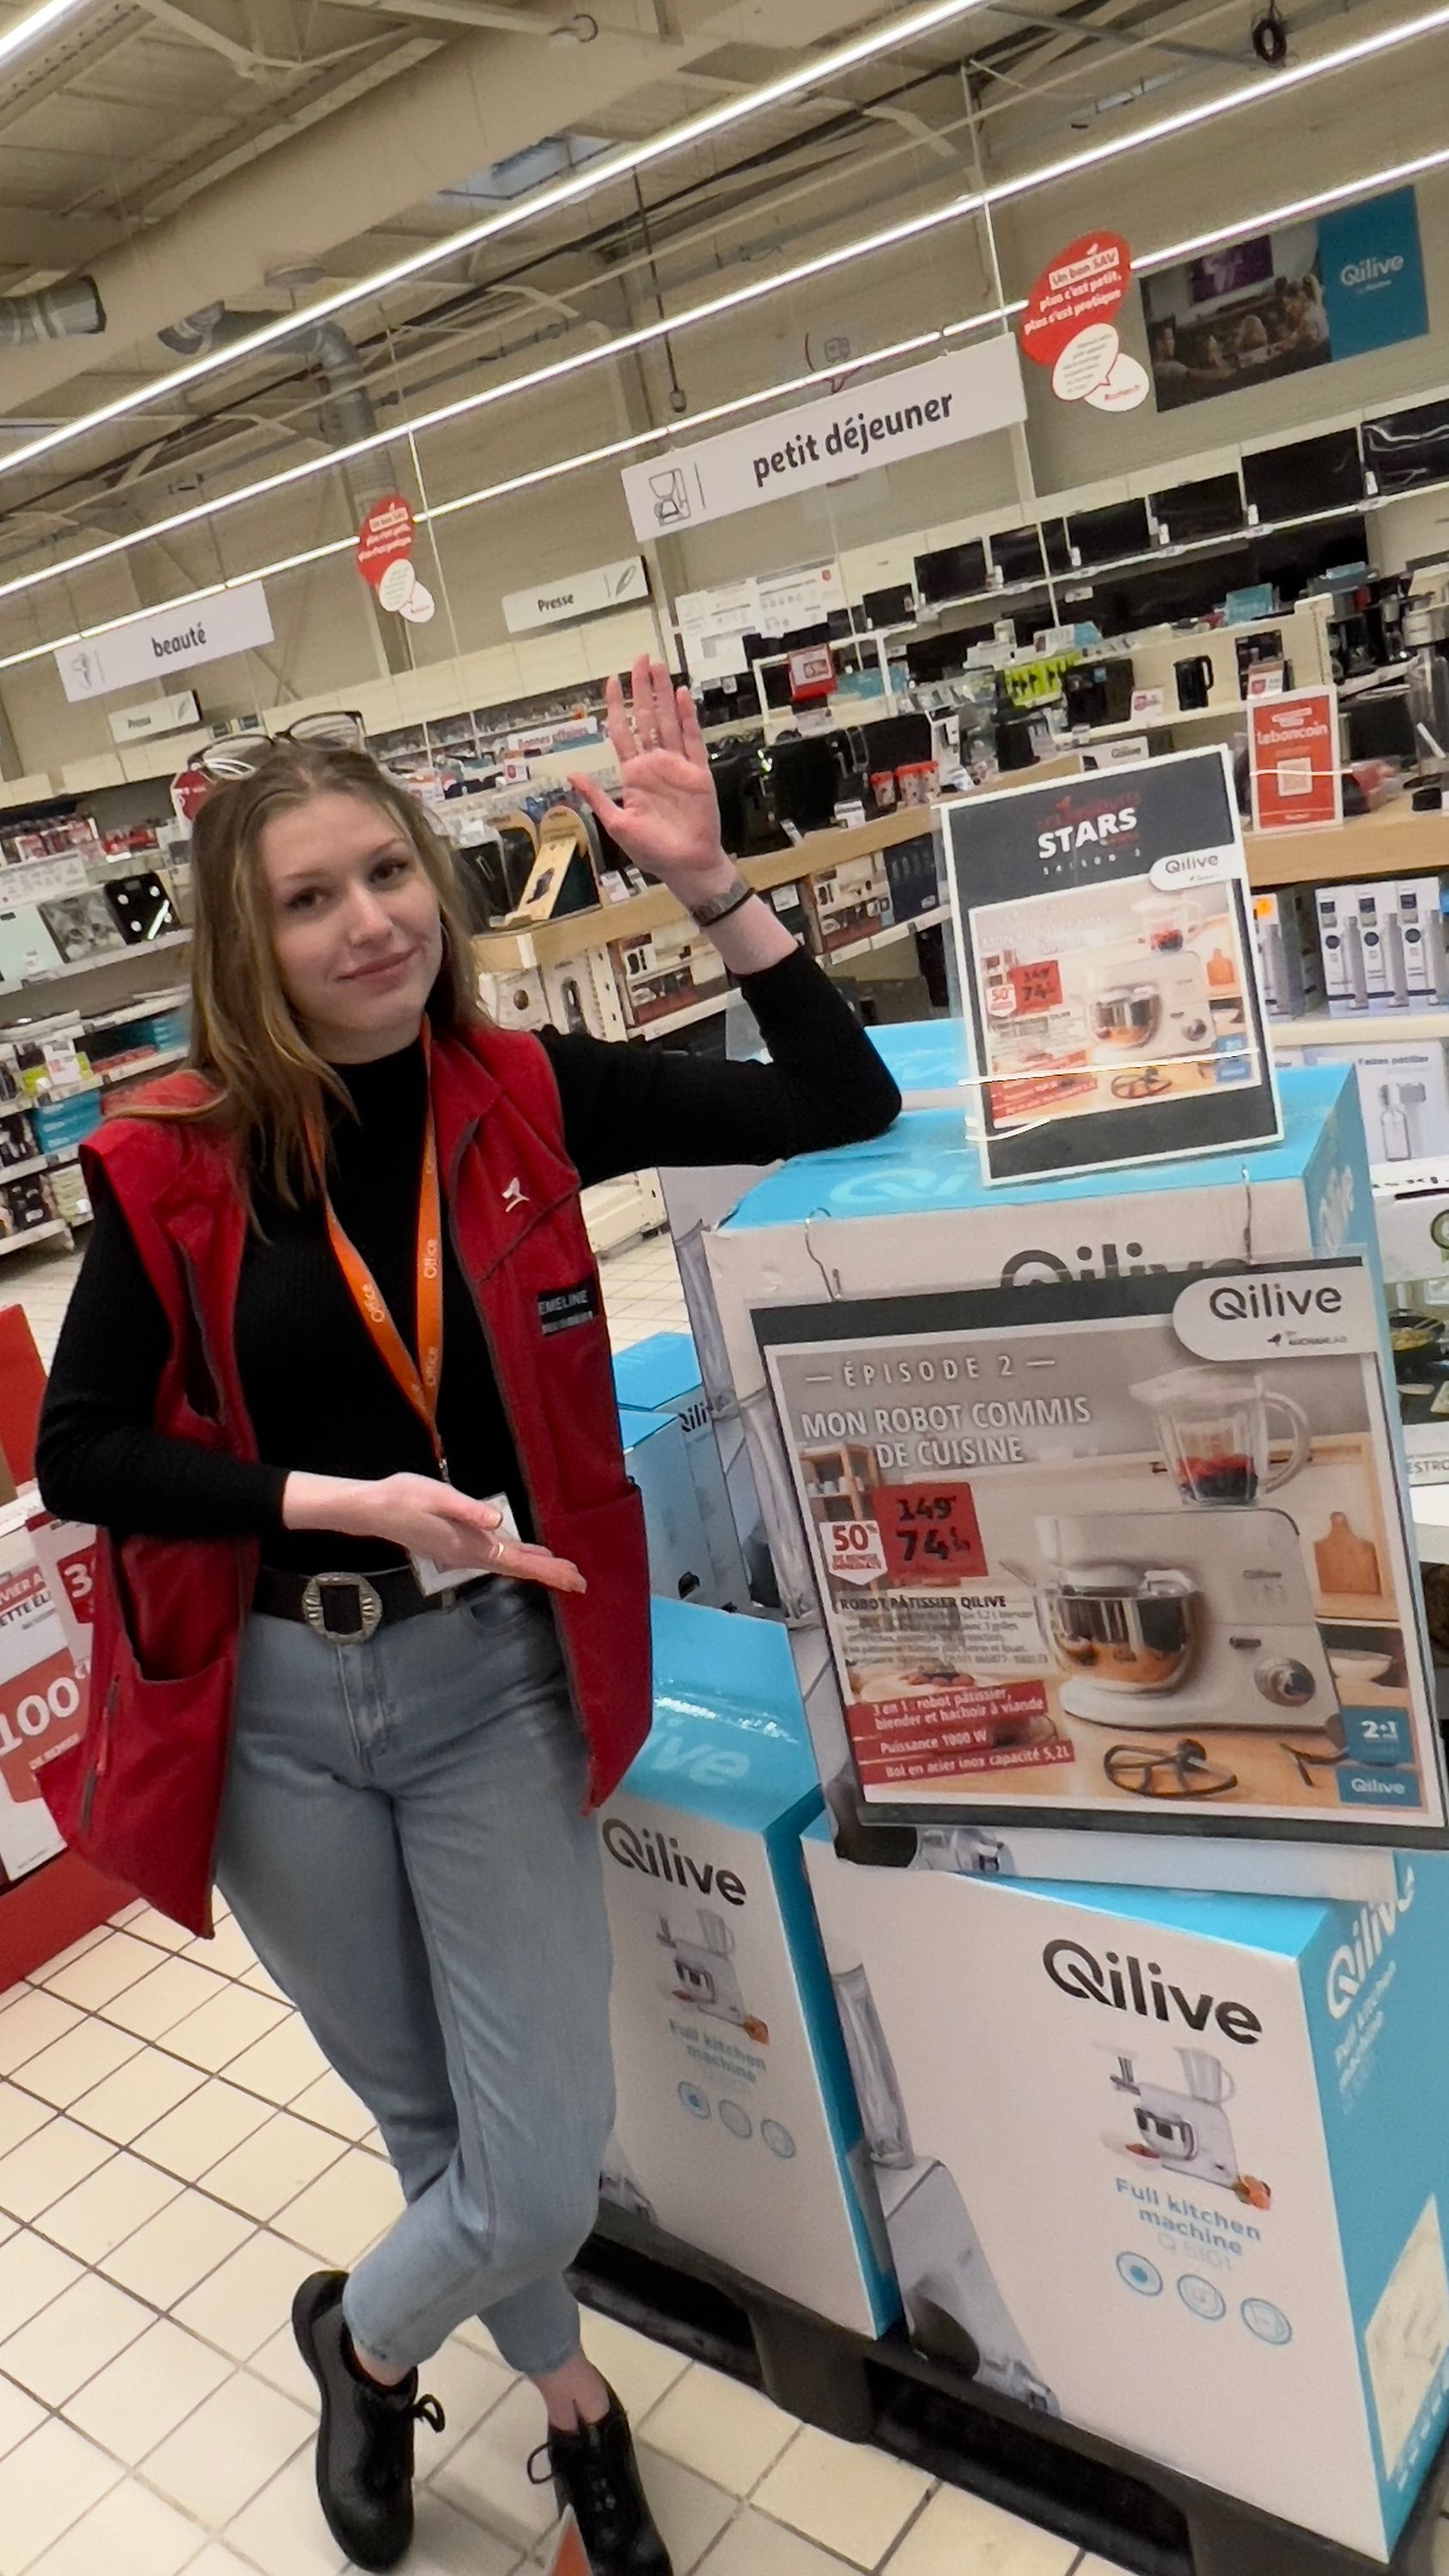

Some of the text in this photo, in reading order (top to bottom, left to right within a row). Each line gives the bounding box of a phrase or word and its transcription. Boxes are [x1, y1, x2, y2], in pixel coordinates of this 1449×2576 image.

[1093, 252, 1116, 270] SAV
[1342, 255, 1404, 288] Qilive
[753, 393, 953, 488] petit déjeuner
[537, 592, 575, 612] Presse
[151, 621, 207, 658] beauté
[1257, 720, 1328, 745] leboncoin
[1038, 807, 1137, 859] STARS
[1165, 855, 1219, 876] Qilive
[1209, 1283, 1342, 1321] Qilive
[843, 1355, 1014, 1388] ÉPISODE 2
[801, 1396, 1092, 1439] MON ROBOT COMMIS
[876, 1436, 1025, 1469] DE CUISINE
[840, 1595, 1006, 1611] ROBOT PÂTISSIER QILIVE
[874, 1714, 921, 1730] blender
[924, 1711, 938, 1723] et
[940, 1704, 987, 1722] hachoir
[1001, 1698, 1044, 1714] viande
[882, 1703, 898, 1715] en
[916, 1694, 951, 1710] robot
[880, 1737, 939, 1754] Puissance
[973, 1729, 987, 1743] W
[886, 1765, 906, 1778] Bol
[908, 1764, 923, 1776] en
[927, 1759, 956, 1773] acier
[959, 1756, 986, 1769] inox
[988, 1748, 1040, 1767] capacité
[1350, 1777, 1406, 1795] Qilive
[602, 1818, 746, 1906] Qilive
[1043, 1939, 1263, 2045] Qilive
[1116, 2178, 1261, 2241] Full kitchen
[1139, 2208, 1243, 2256] machine
